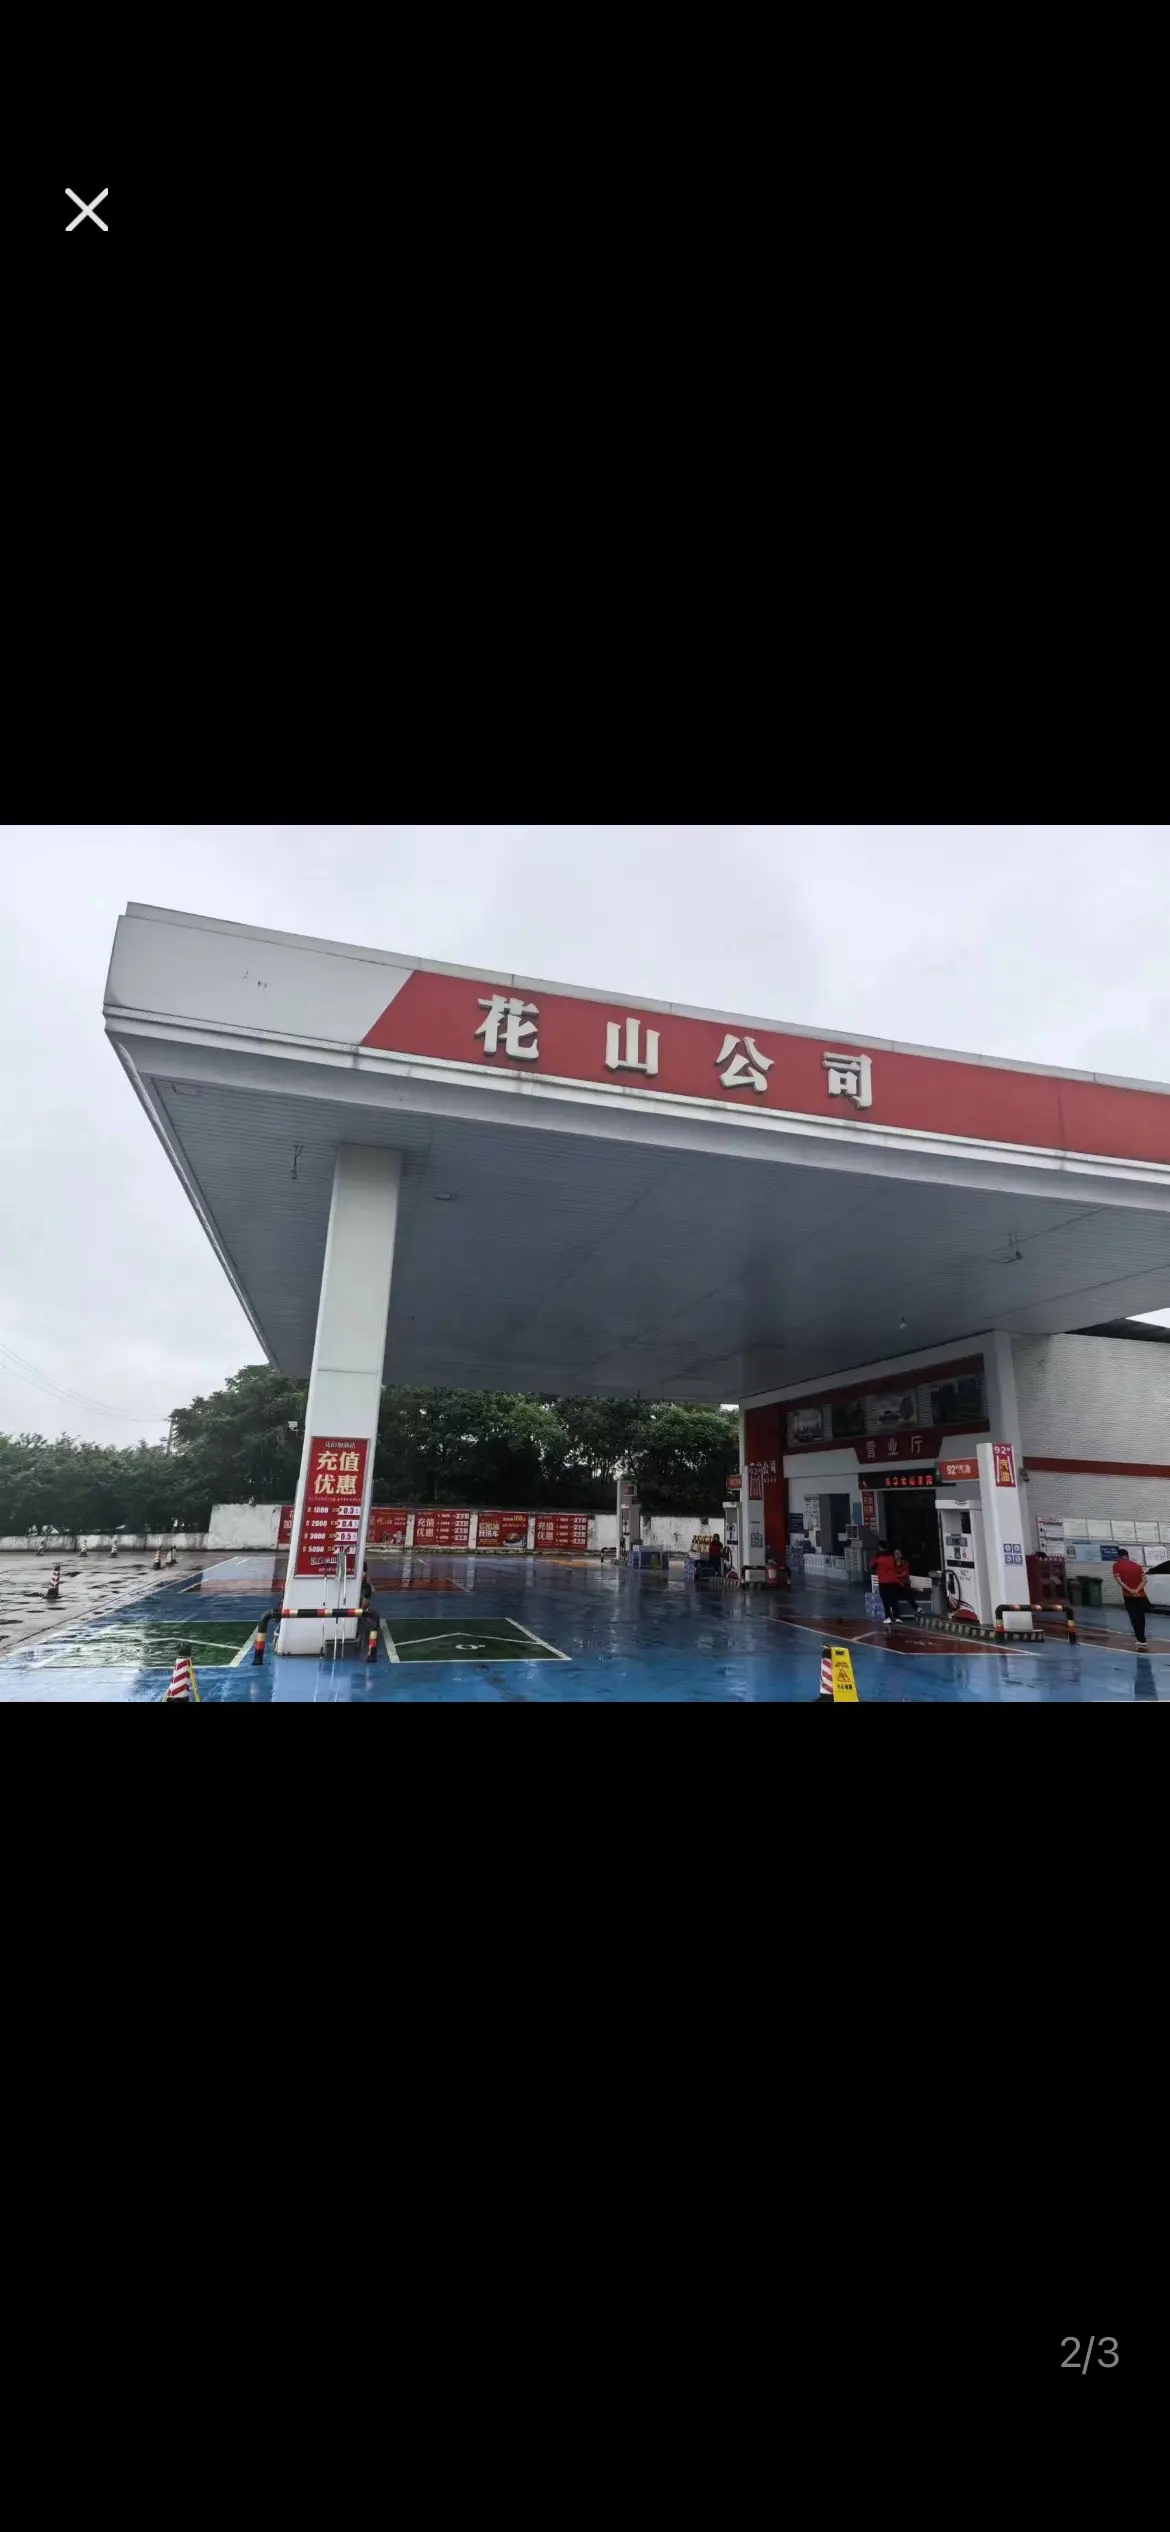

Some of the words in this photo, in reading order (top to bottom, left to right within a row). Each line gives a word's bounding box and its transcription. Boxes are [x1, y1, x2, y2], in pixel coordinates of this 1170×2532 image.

[474, 994, 872, 1109] 花山公司
[866, 1434, 923, 1460] 营业厅
[316, 1450, 360, 1471] 充值
[1000, 1459, 1010, 1482] 汽油
[314, 1473, 357, 1494] 优惠
